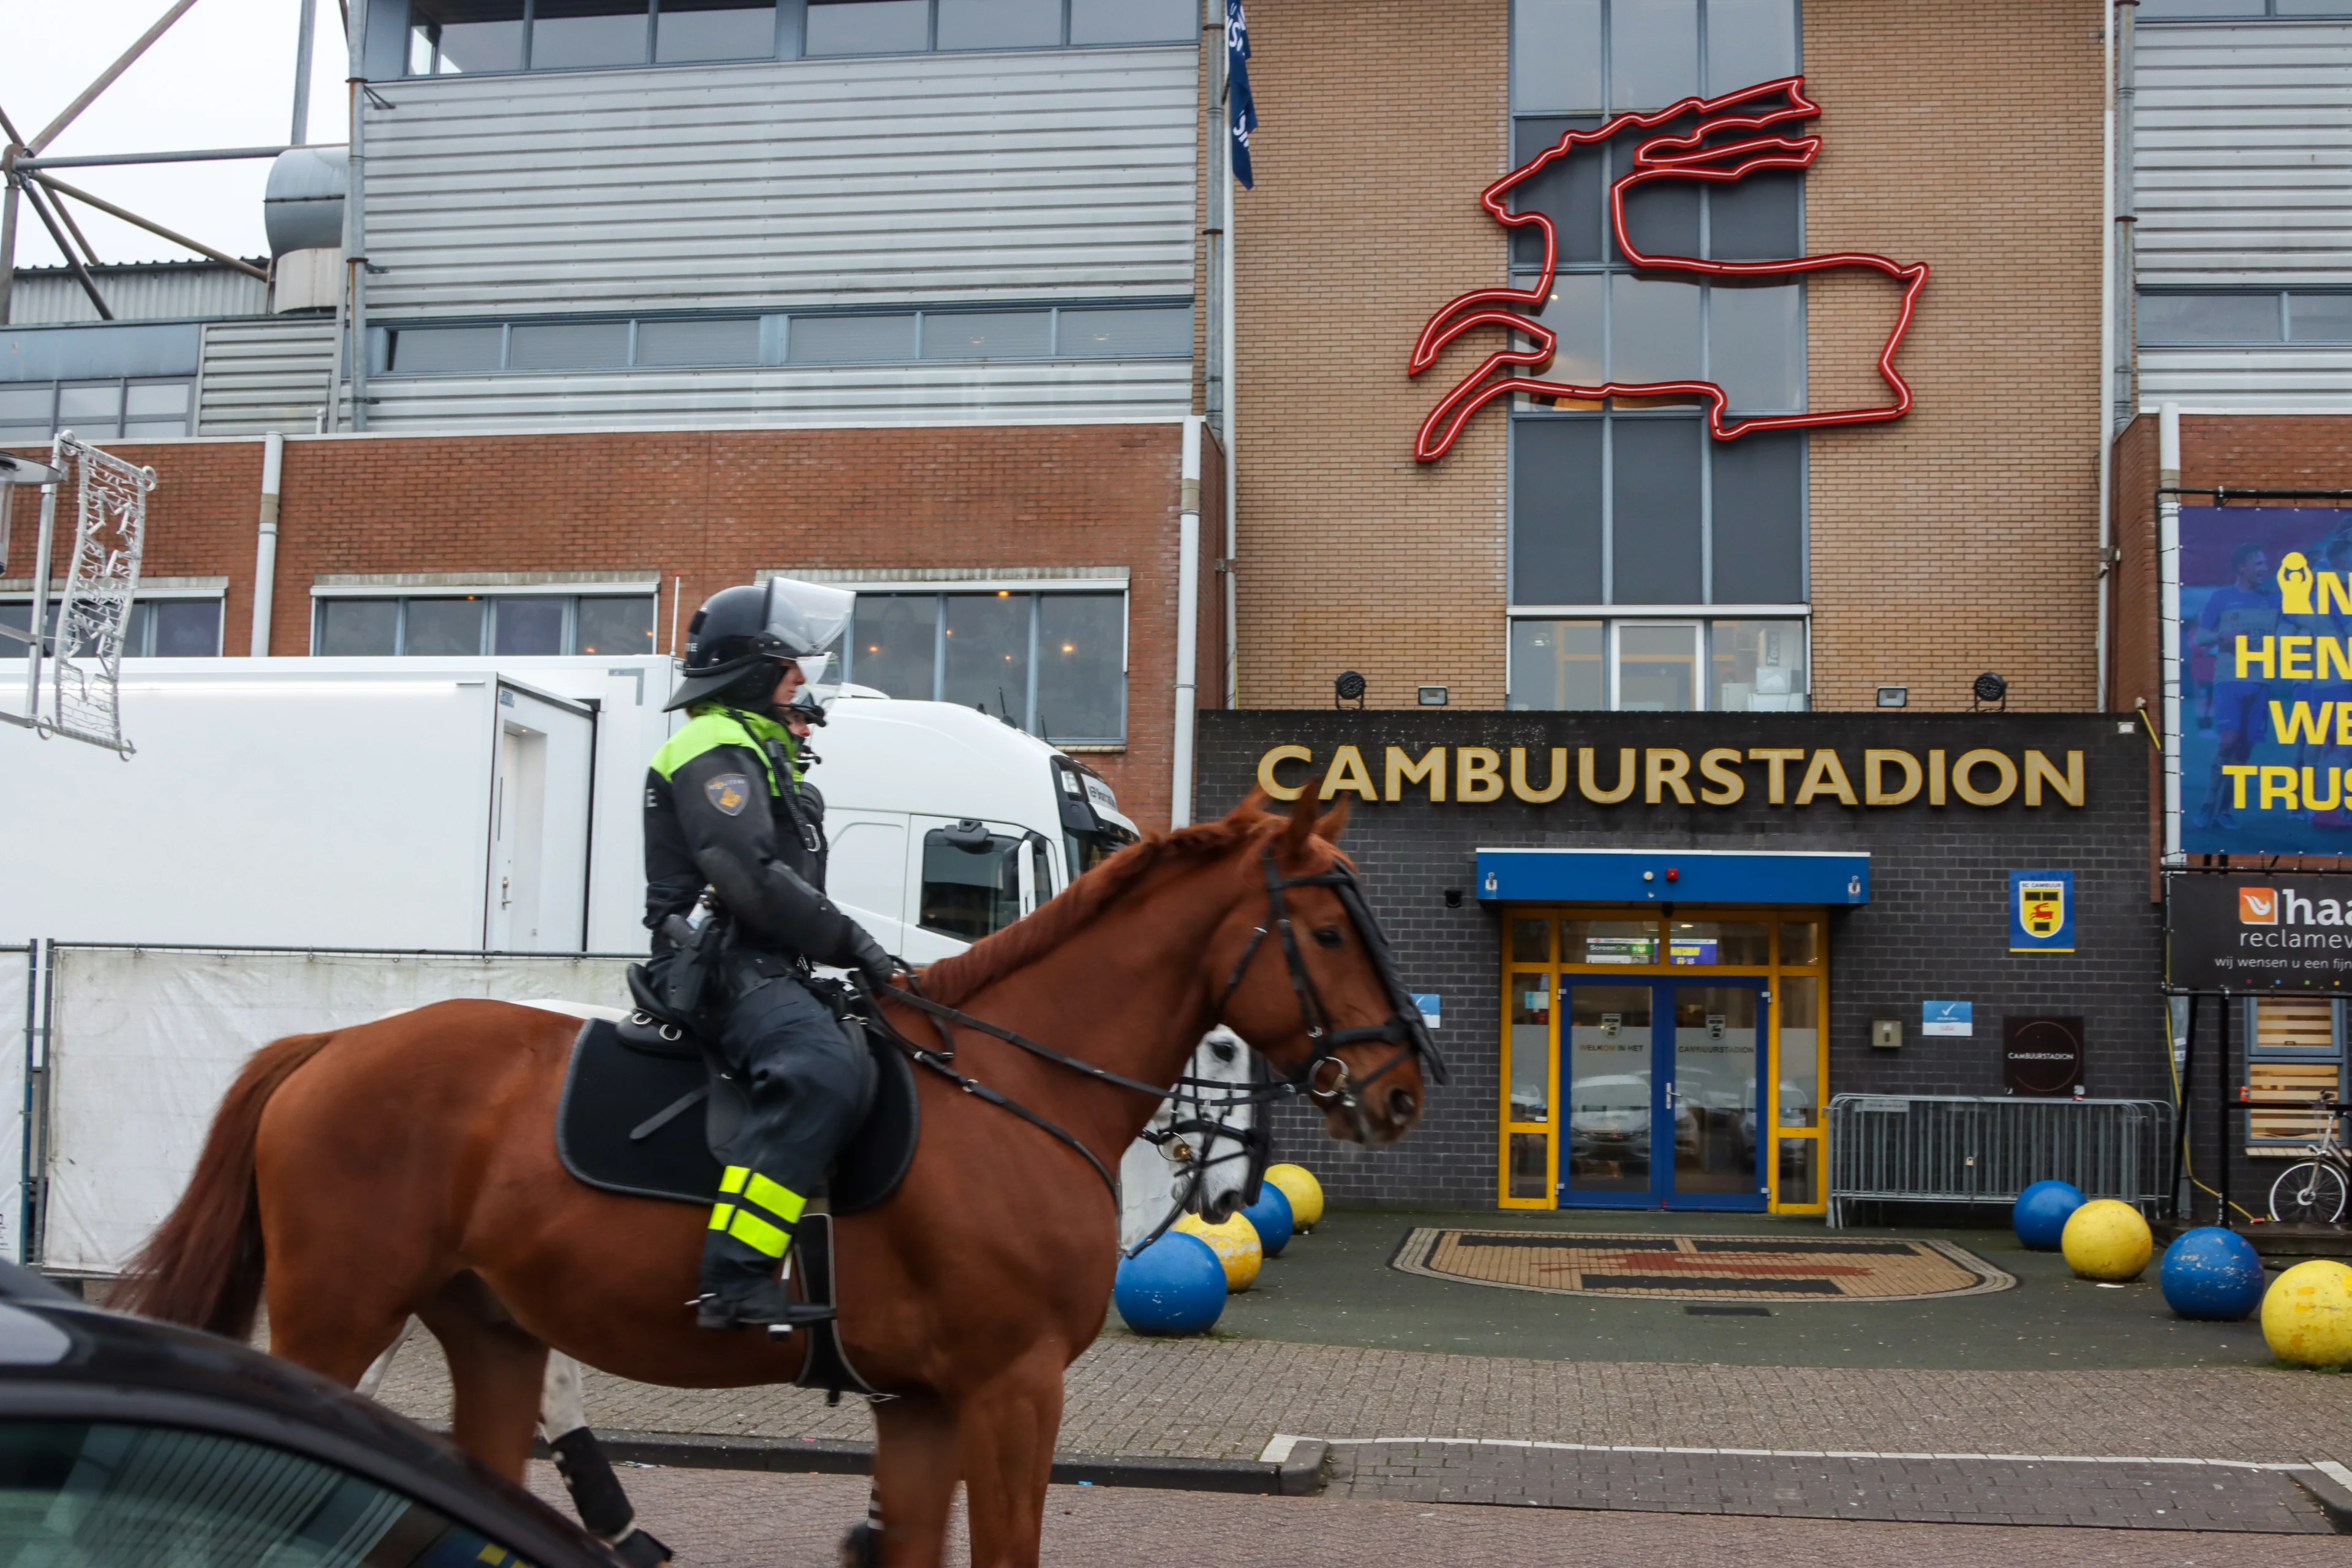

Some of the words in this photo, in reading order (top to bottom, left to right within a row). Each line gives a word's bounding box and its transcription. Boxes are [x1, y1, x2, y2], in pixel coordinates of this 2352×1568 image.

[2235, 635, 2352, 680] HEN
[1256, 745, 2085, 807] CAMBUURSTADION
[2222, 765, 2352, 812] TRU
[2282, 889, 2352, 926] ha
[2214, 956, 2233, 970] wij
[2237, 958, 2288, 968] wensen
[2292, 960, 2300, 968] u
[2304, 959, 2329, 969] een
